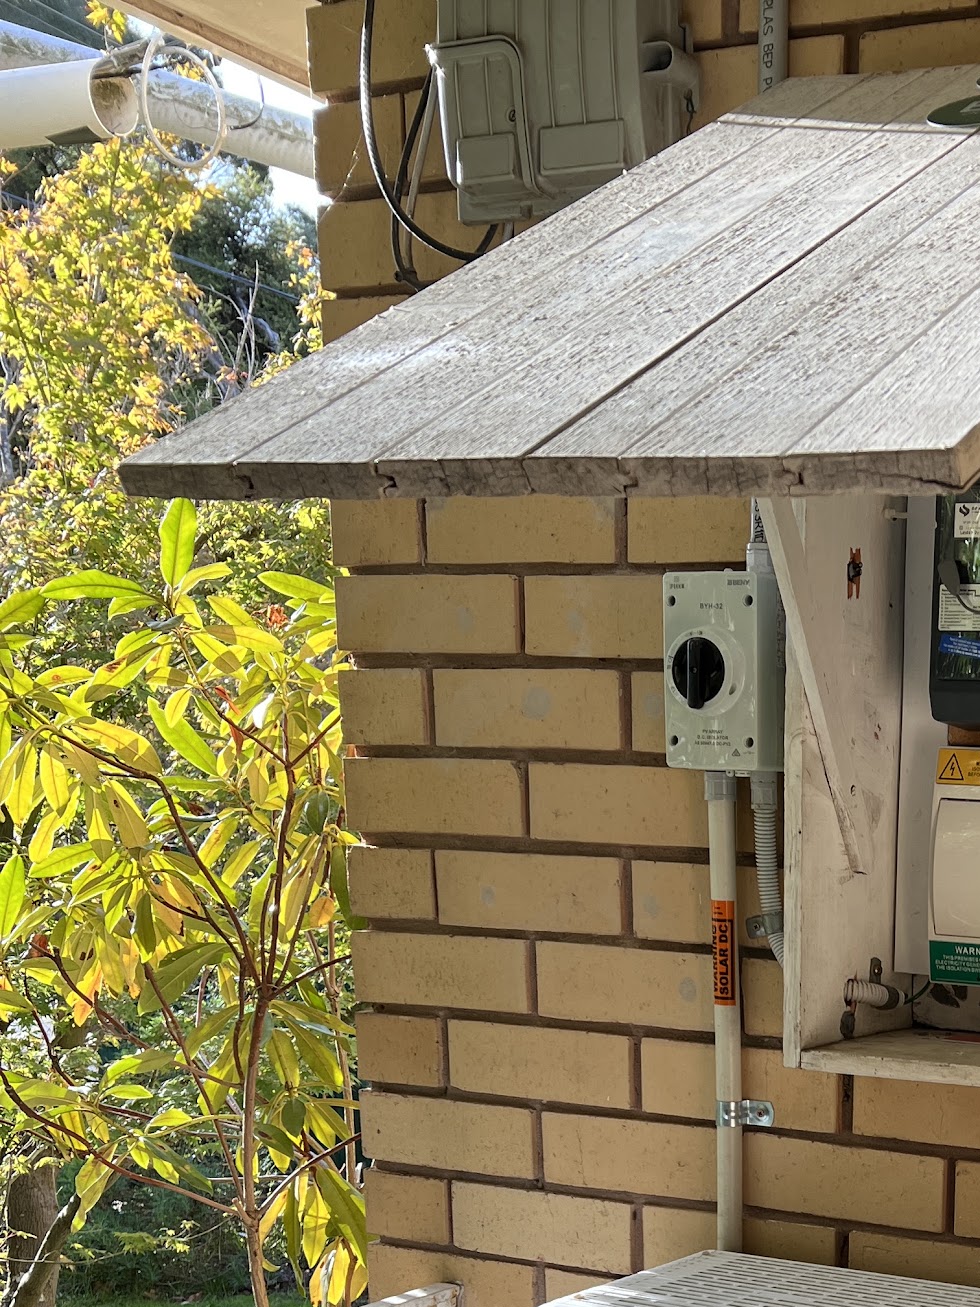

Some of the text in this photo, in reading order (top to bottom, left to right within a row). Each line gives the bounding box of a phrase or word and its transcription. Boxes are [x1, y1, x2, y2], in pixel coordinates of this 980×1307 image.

[763, 43, 774, 68] BEP
[719, 924, 729, 995] SOLAR DC
